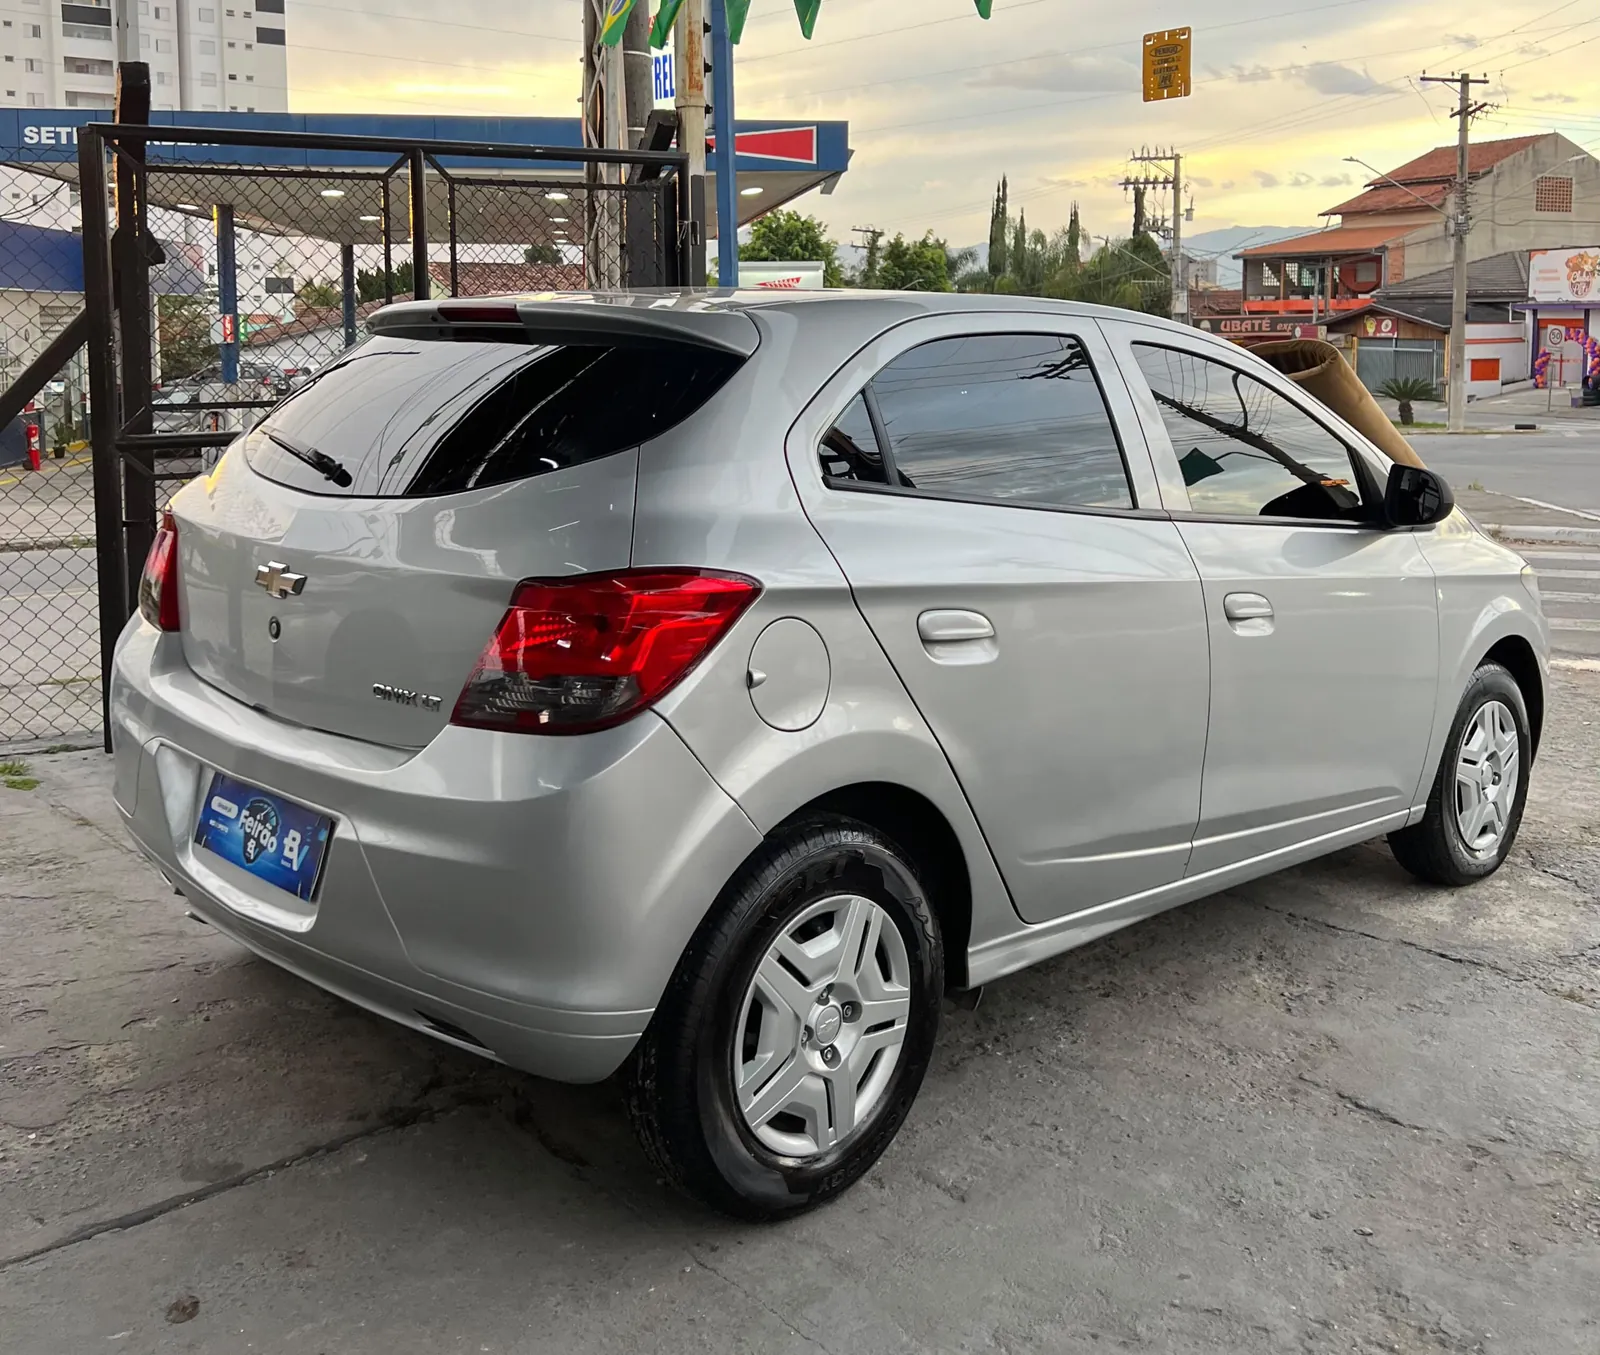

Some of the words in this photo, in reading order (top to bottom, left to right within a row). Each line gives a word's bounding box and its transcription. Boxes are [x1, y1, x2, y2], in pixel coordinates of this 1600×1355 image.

[1220, 317, 1271, 332] UBATÉ
[1551, 332, 1560, 340] 50
[372, 682, 418, 707] ONIX
[239, 809, 277, 853] Feirão
